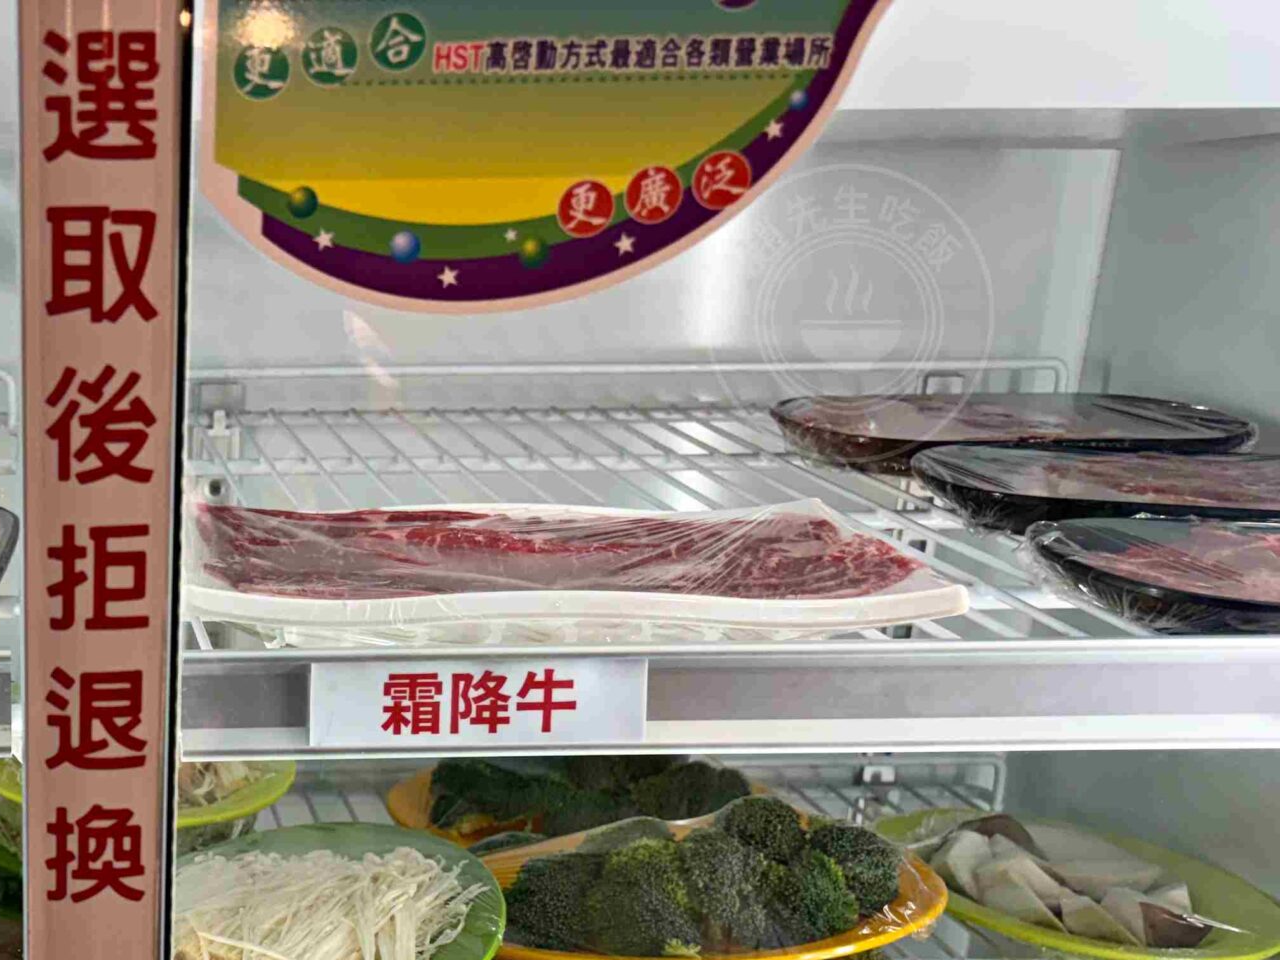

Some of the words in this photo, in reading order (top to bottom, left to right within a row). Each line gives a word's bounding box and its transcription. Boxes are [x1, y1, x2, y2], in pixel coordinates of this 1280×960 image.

[239, 15, 424, 96] 更適合
[562, 155, 750, 232] 更廣泛
[42, 29, 160, 904] 選取後拒退換
[380, 668, 577, 736] 霜降牛
